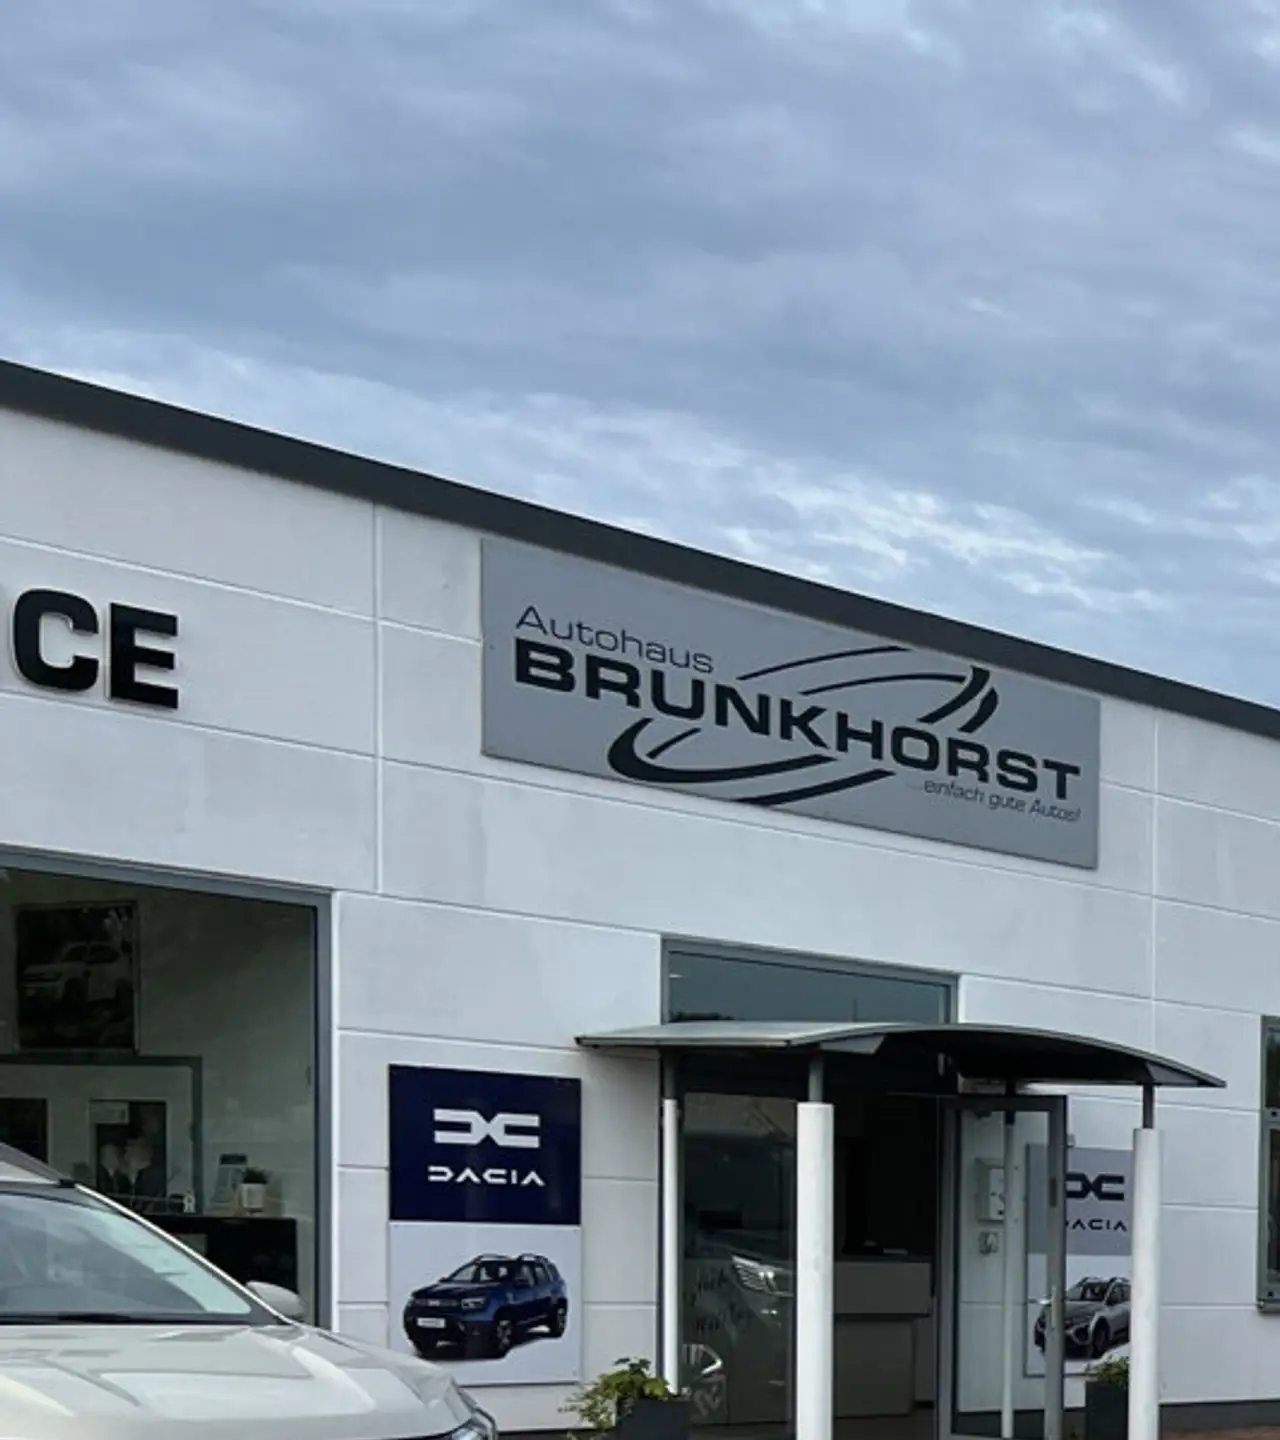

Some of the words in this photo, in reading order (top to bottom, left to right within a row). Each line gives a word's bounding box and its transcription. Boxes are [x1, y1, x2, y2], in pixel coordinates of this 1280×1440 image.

[13, 588, 179, 709] CE
[514, 604, 714, 674] Autohaus
[514, 637, 1082, 800] BRUNKHORST
[988, 792, 1027, 812] gute
[427, 1165, 546, 1187] DACIA
